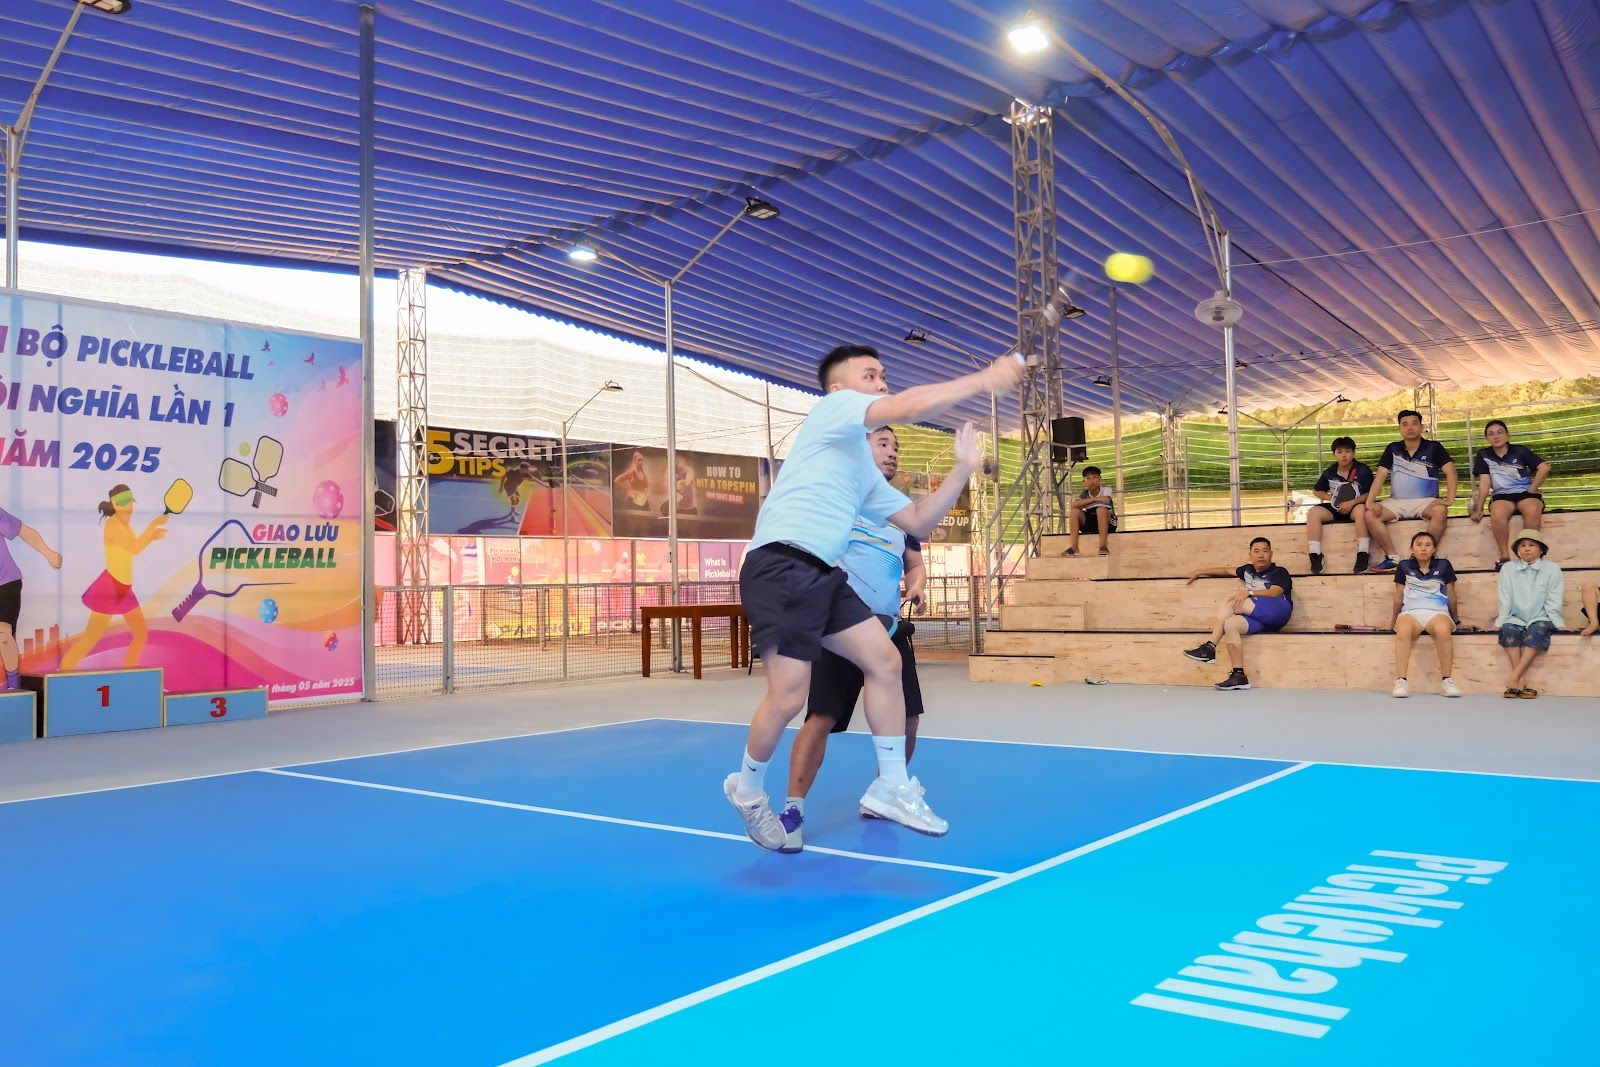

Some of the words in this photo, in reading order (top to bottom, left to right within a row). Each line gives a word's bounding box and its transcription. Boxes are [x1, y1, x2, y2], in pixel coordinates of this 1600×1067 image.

[16, 324, 68, 368] BỘ
[76, 335, 255, 380] PICKLEBALL
[28, 384, 140, 420] NGHĨA
[149, 383, 211, 426] LẦN
[223, 402, 235, 427] 1
[69, 442, 161, 473] 2025
[420, 430, 455, 475] 5
[453, 432, 556, 462] SECRET
[458, 458, 506, 478] TIPS
[706, 466, 727, 478] HOW
[729, 466, 741, 478] TO
[717, 479, 756, 494] TOPSPIN
[252, 523, 298, 542] GIAO
[305, 521, 340, 542] LƯU
[956, 516, 969, 527] UP
[209, 547, 337, 569] PICKLEBALL
[704, 558, 720, 567] What
[272, 683, 296, 693] tháng
[298, 681, 311, 690] 05
[312, 679, 331, 689] năm
[332, 677, 355, 688] 2025
[97, 685, 110, 707] 1
[210, 697, 227, 718] 3
[1129, 849, 1509, 1039] Pickleball
